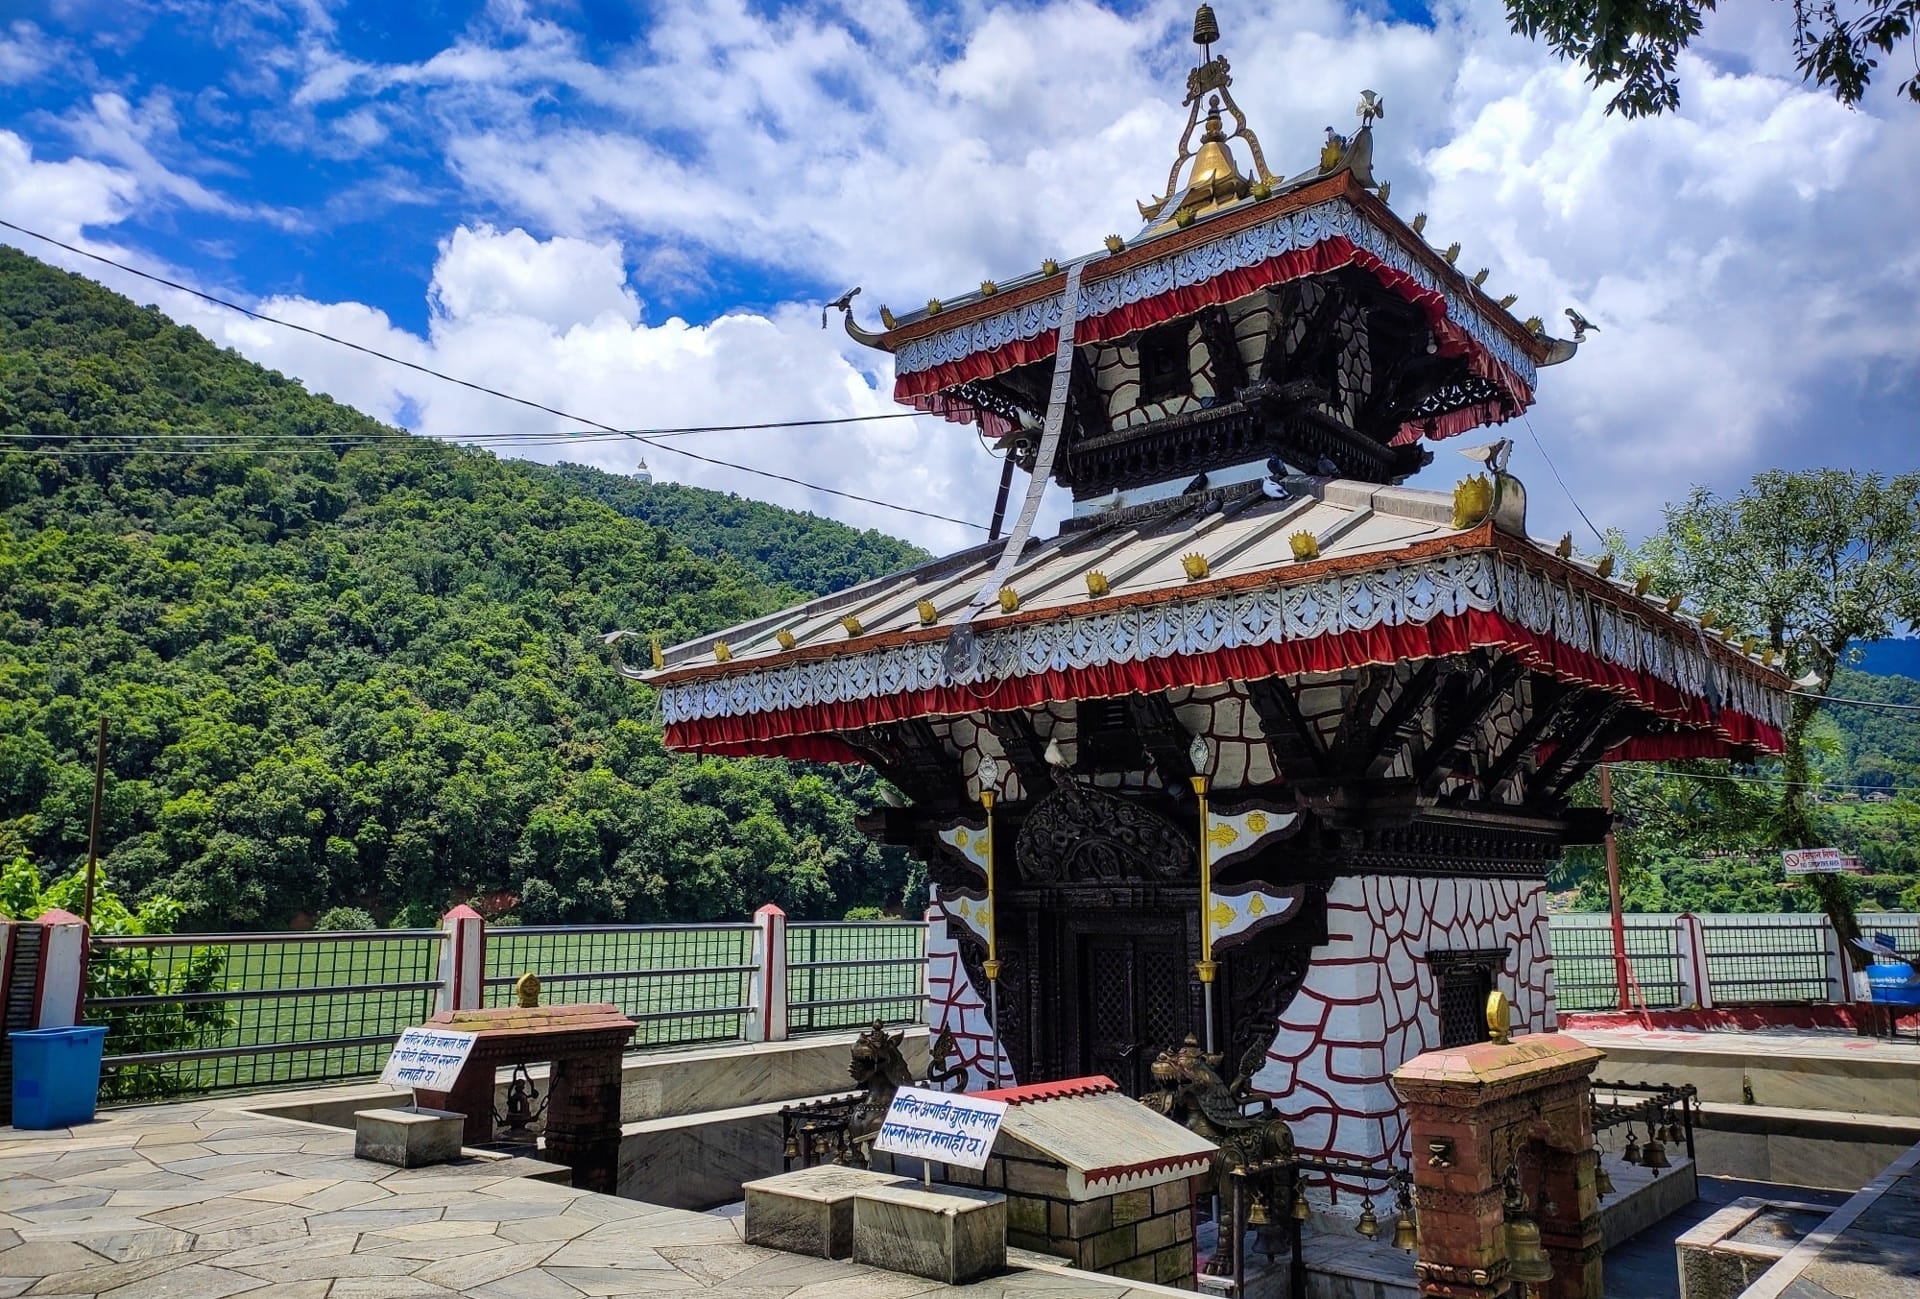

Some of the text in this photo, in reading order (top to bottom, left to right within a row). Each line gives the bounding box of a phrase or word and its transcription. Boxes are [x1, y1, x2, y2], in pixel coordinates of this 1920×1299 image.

[397, 1066, 426, 1085] मनाही
[892, 1094, 923, 1120] मन्दिर
[971, 1110, 1002, 1132] चप्पल
[931, 1130, 969, 1157] मनाही
